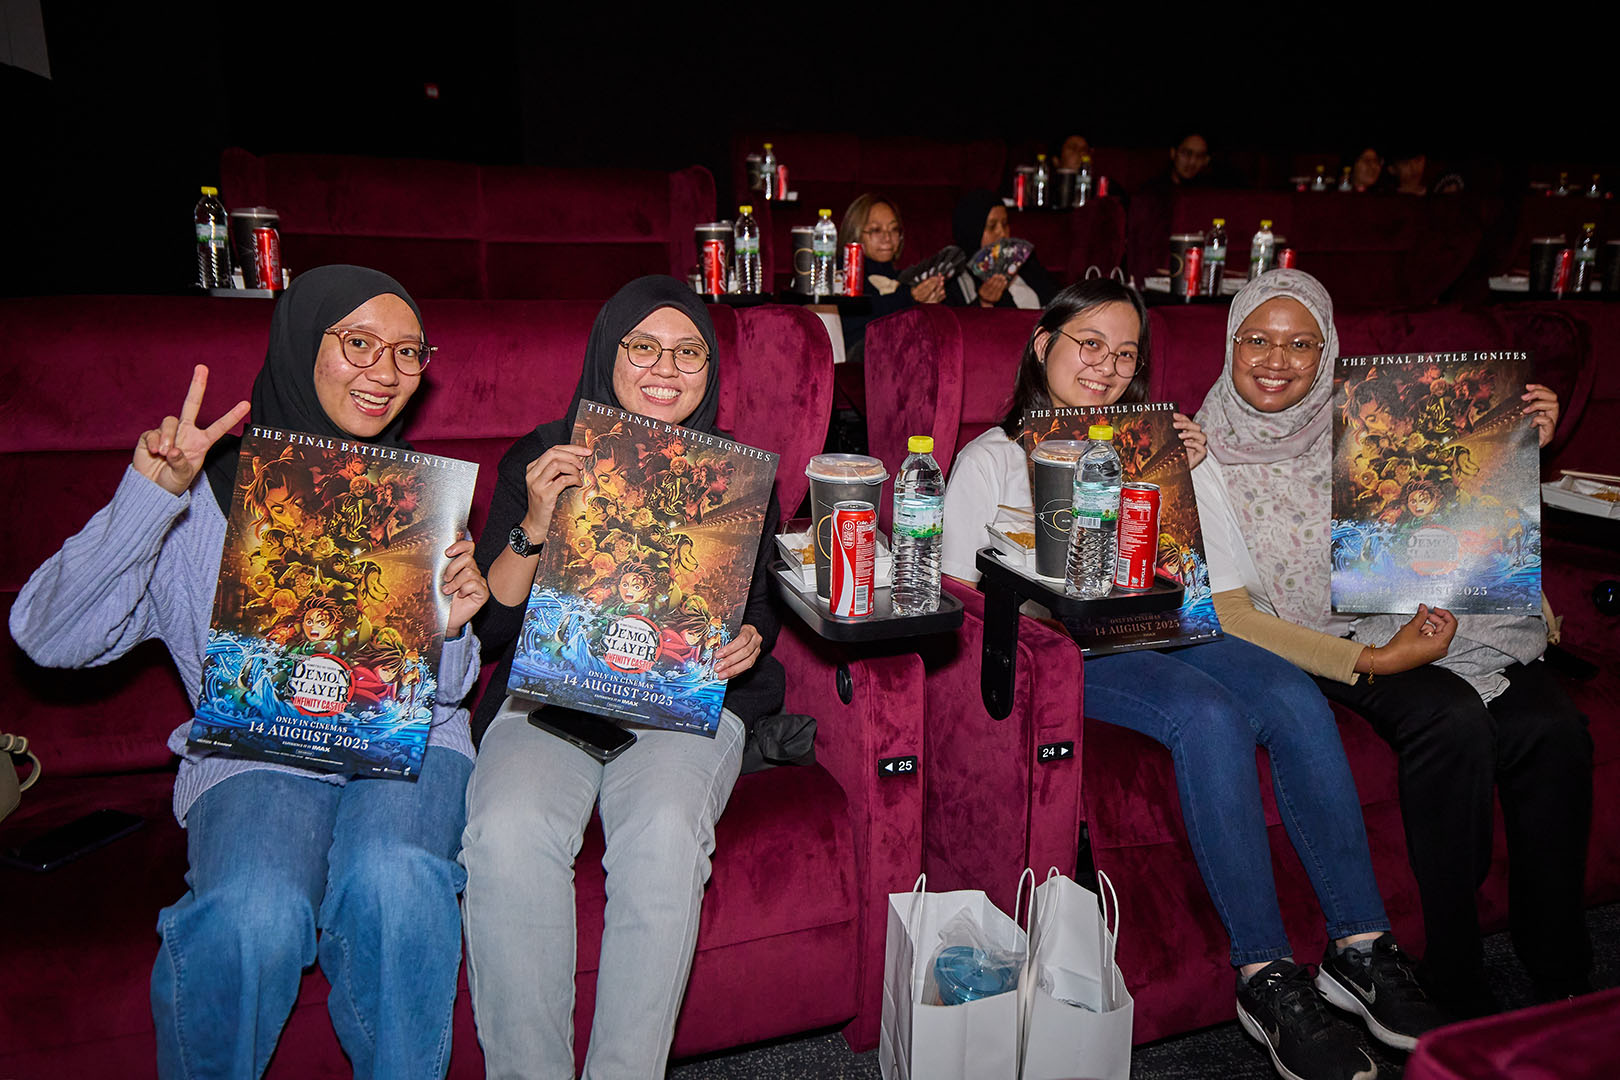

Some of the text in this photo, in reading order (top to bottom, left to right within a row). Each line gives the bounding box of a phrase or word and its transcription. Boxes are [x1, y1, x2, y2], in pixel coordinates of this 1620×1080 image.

[1342, 352, 1527, 366] THE FINAL BATTLE IGNITES
[1030, 402, 1175, 418] THE FINAL BATTLE IGNITES
[588, 403, 771, 462] THE FINAL BATTLE IGNITES
[252, 427, 468, 472] THE FINAL BATTLE IGNITES
[604, 620, 660, 648] DEMON
[1095, 619, 1180, 636] 14 AUGUST 2025
[600, 637, 656, 662] SLAYER
[607, 652, 655, 671] INFINITY CASTLE
[291, 659, 353, 687] DEMON
[588, 670, 654, 690] ONLY IN CINEMAS
[284, 679, 349, 702] SLAYER
[563, 674, 578, 686] 14
[581, 678, 640, 699] AUGUST
[642, 690, 674, 706] 2025
[294, 696, 346, 712] INFINITY CASTLE
[622, 699, 639, 707] IMAX
[276, 715, 348, 733] ONLY IN CINEMAS
[248, 721, 369, 751] 14 AUGUST 2025
[312, 745, 331, 753] IMAX
[1042, 747, 1055, 758] 24
[898, 761, 912, 772] 25
